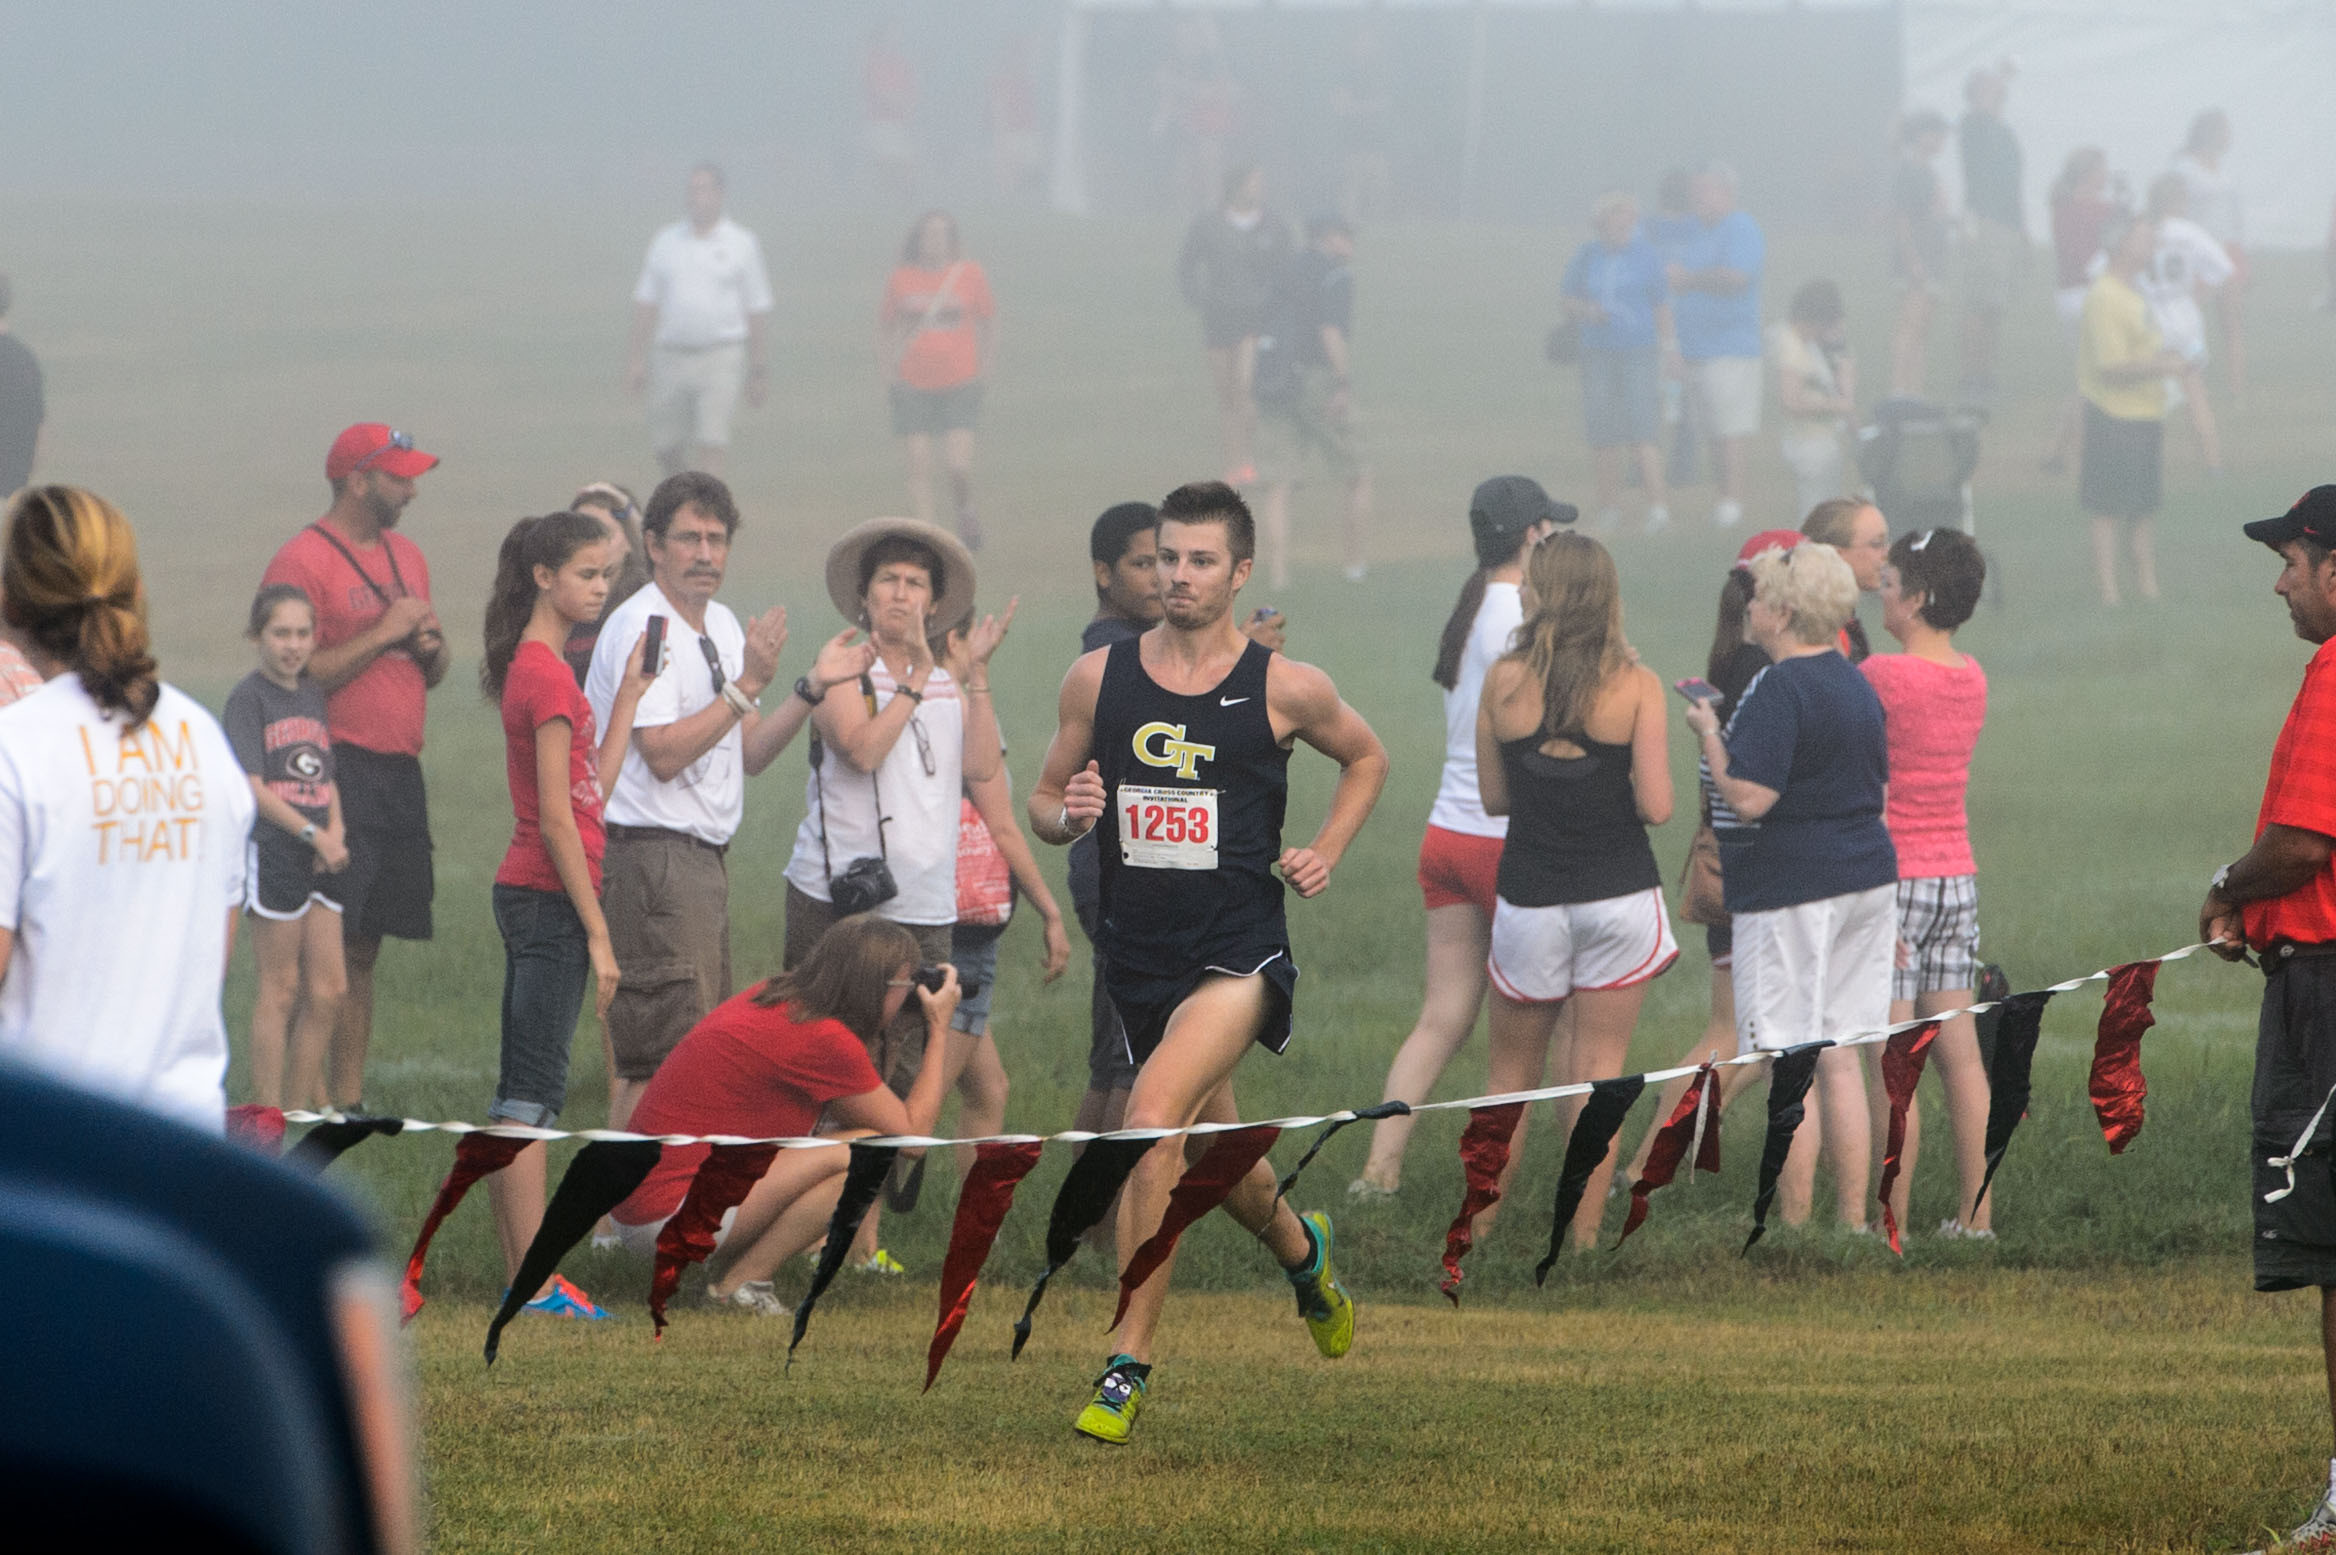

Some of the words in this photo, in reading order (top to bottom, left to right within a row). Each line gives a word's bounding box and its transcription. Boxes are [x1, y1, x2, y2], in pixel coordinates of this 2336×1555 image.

[78, 723, 96, 775] I
[117, 719, 199, 773] AM
[1132, 721, 1216, 781] GT
[92, 774, 203, 817] DOING
[1124, 787, 1152, 796] GEORGIA
[1154, 788, 1176, 796] CROSS
[1177, 789, 1209, 798] COUNTRY
[1143, 795, 1188, 803] INVITATIONAL
[1125, 804, 1209, 844] 1253
